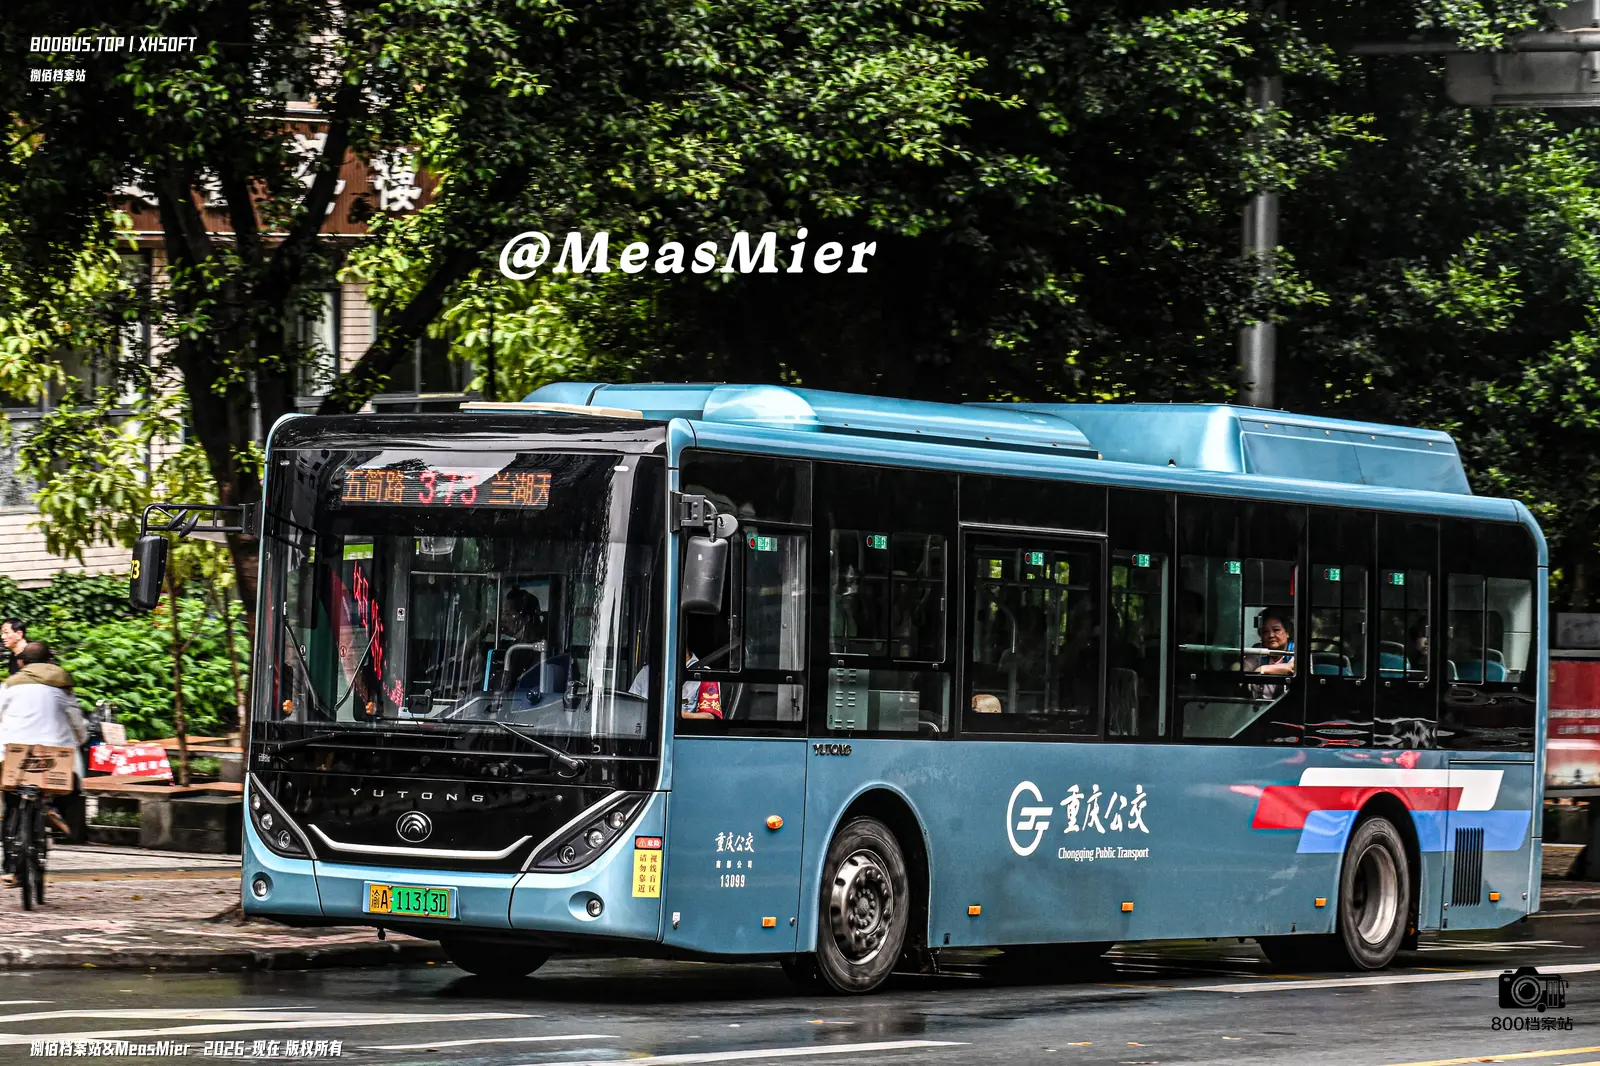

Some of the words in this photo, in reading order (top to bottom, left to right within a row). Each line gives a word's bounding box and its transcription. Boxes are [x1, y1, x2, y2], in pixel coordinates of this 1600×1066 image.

[342, 469, 405, 503] 五简路
[418, 469, 478, 505] 373
[489, 472, 552, 506] 兰湖天
[350, 787, 484, 803] YUTONG
[1059, 783, 1150, 834] 重庆公交
[647, 839, 660, 847] 危险
[714, 831, 755, 853] 重庆公交
[1058, 847, 1094, 862] Chongqing
[1095, 846, 1116, 859] Public
[1117, 846, 1149, 861] Transport
[720, 874, 746, 888] 13099
